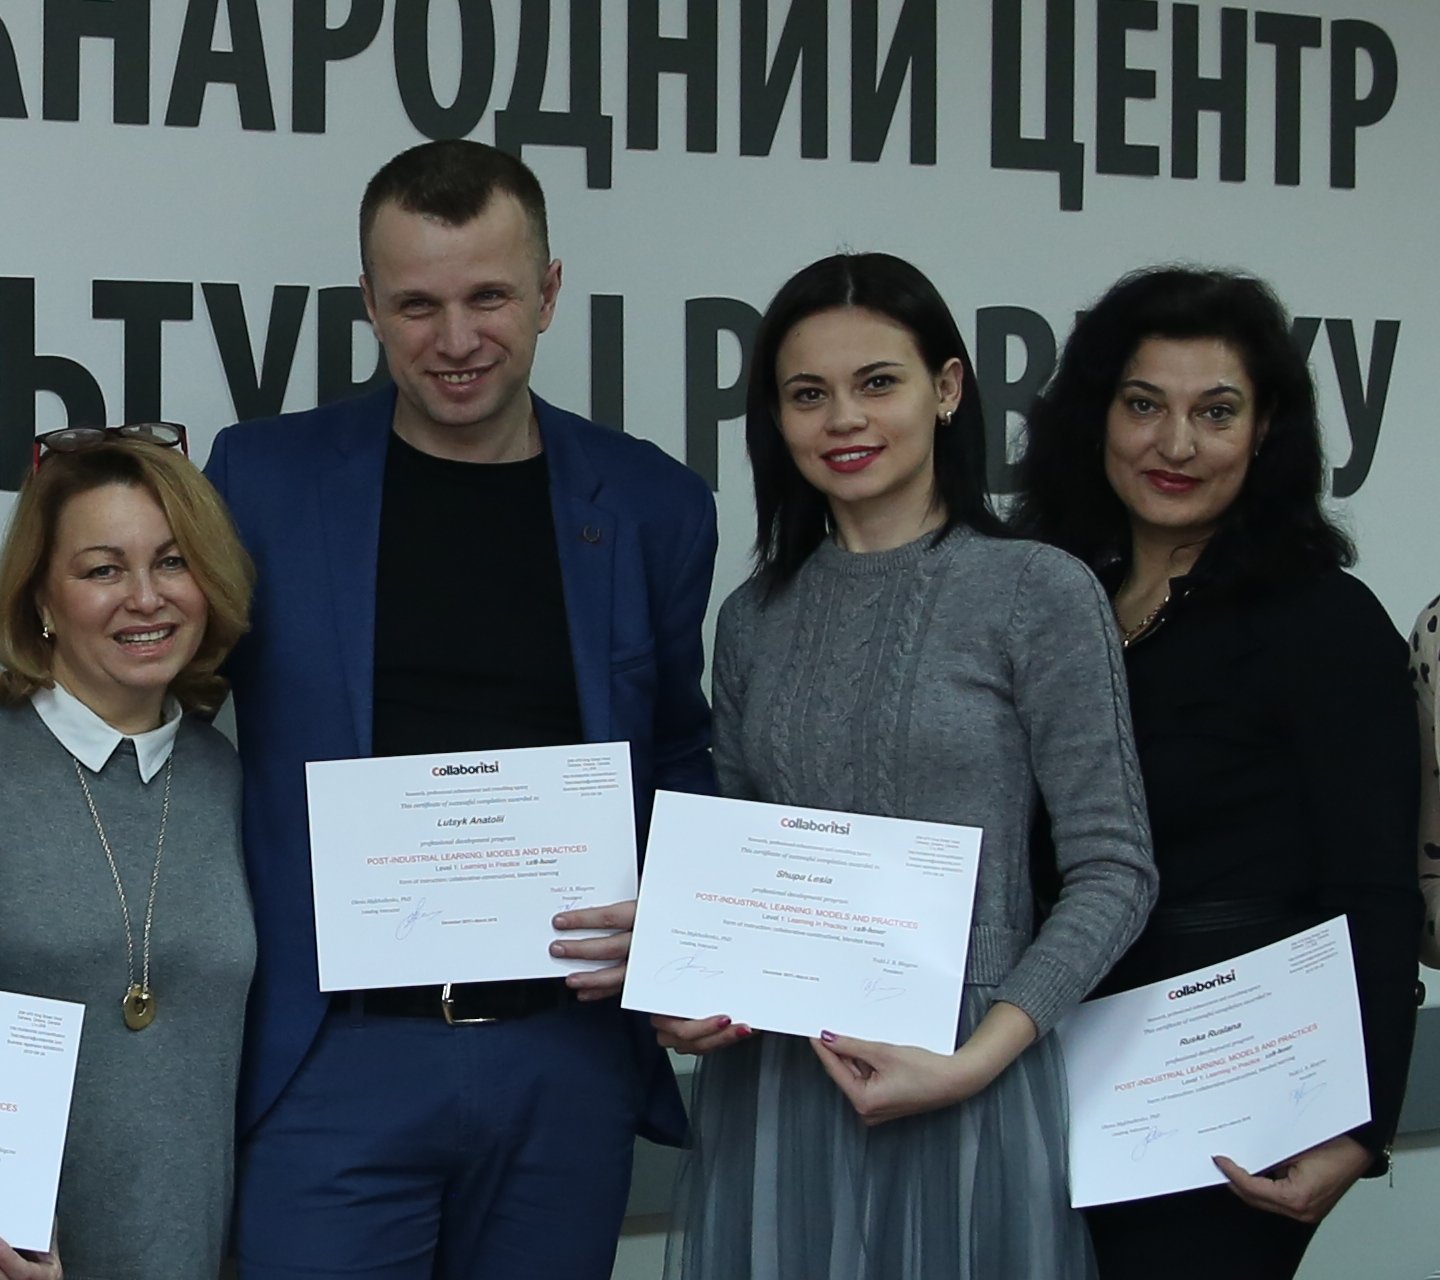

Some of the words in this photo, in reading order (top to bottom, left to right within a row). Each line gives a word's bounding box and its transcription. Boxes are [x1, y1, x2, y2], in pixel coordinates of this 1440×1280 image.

[485, 848, 520, 858] MODELS
[521, 846, 539, 856] AND
[540, 843, 587, 855] PRACTICES
[814, 907, 850, 920] MODELS
[850, 912, 870, 923] AND
[870, 915, 919, 929] PRACTICES
[1260, 1037, 1277, 1051] AND
[1277, 1021, 1318, 1044] PRACTICES
